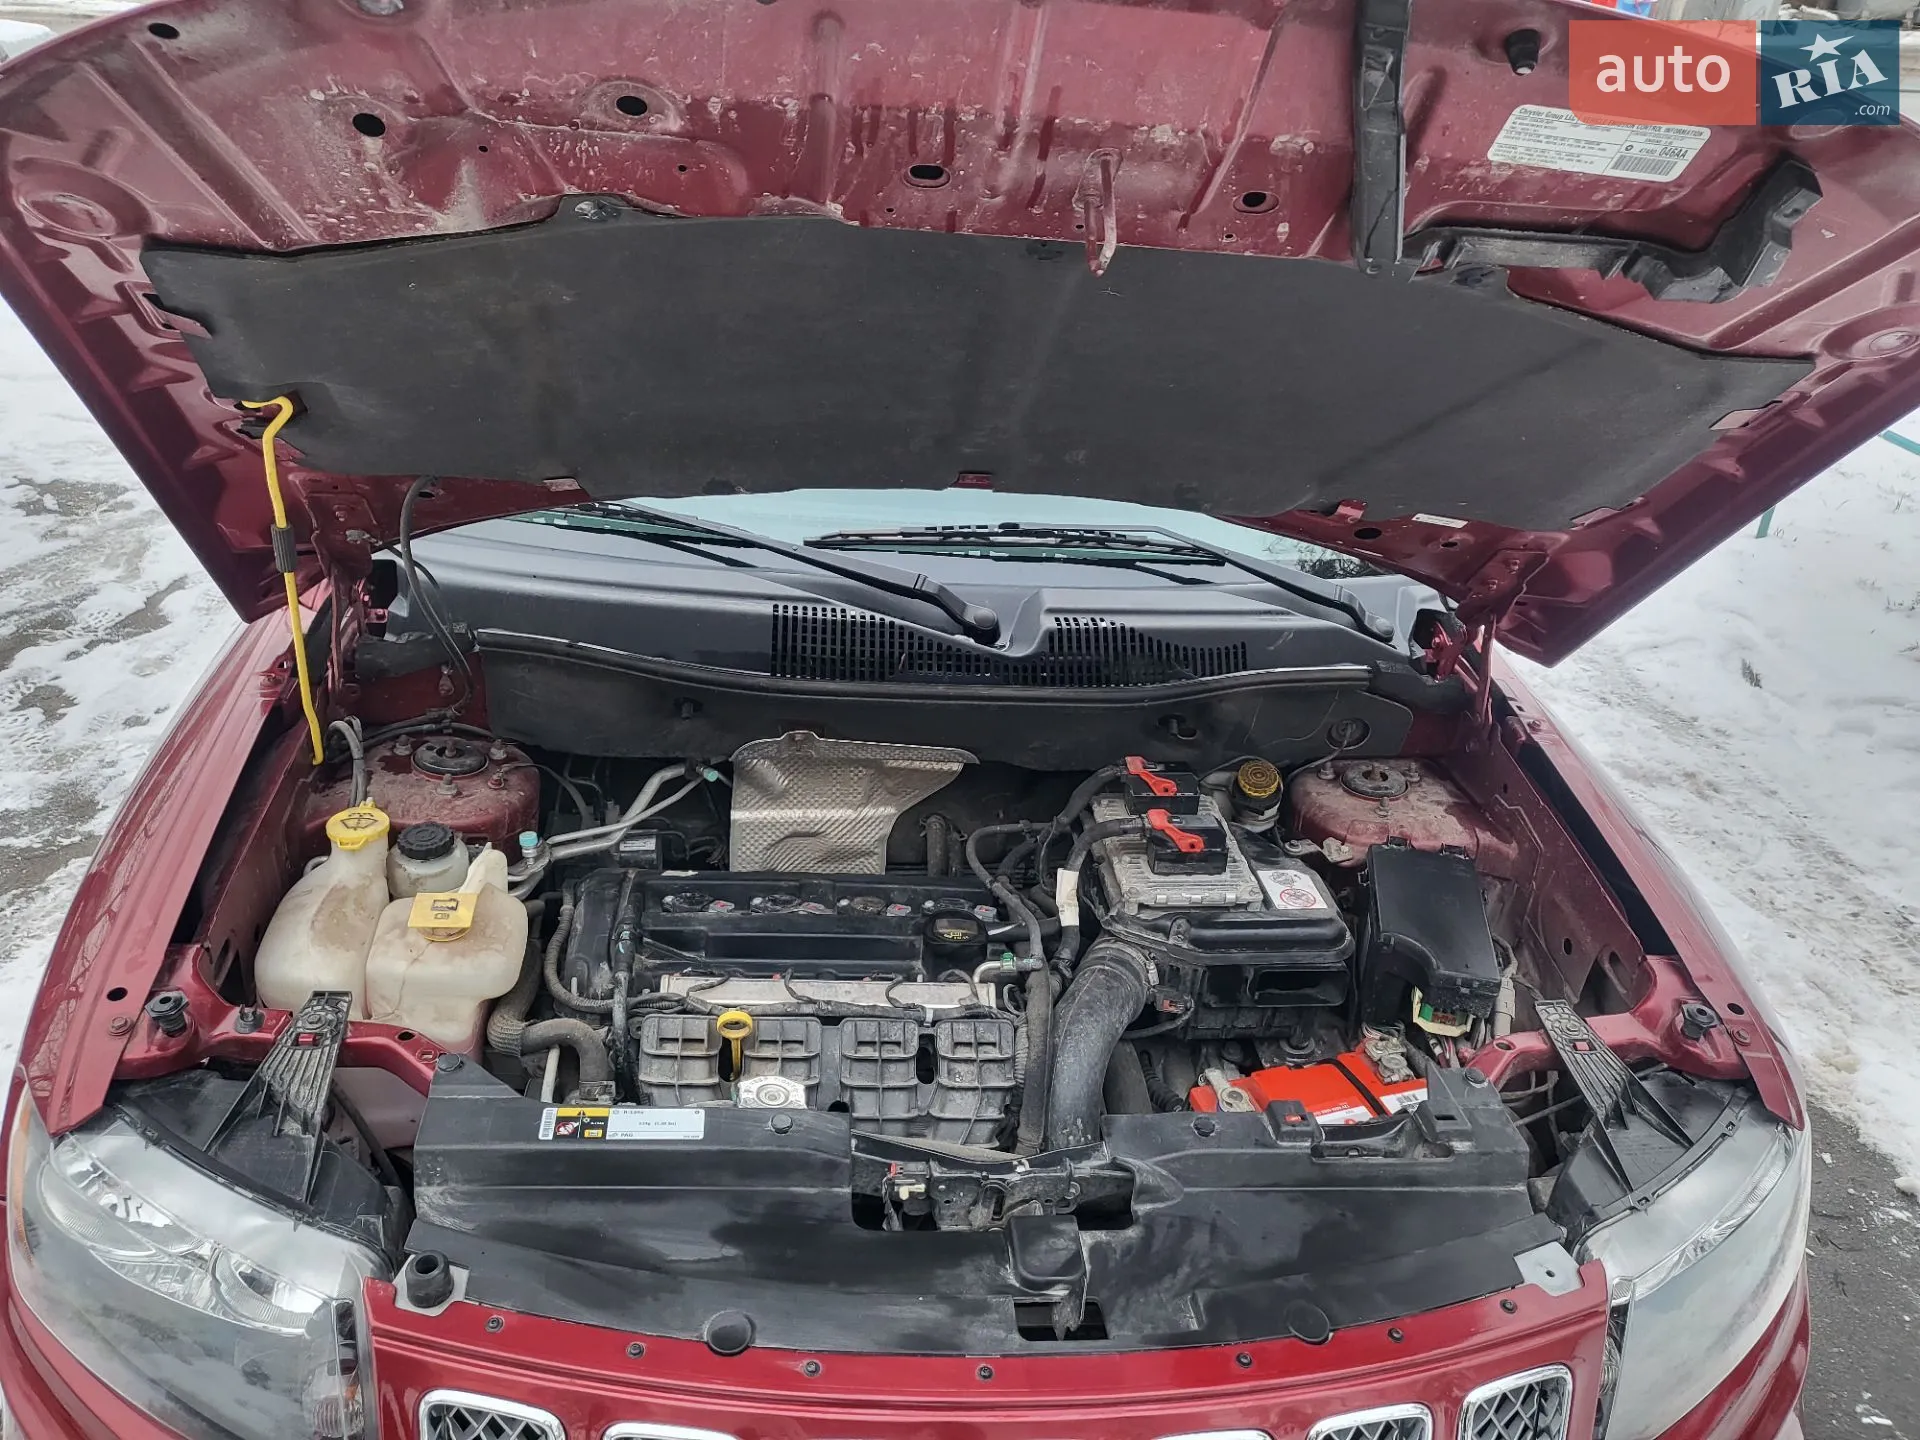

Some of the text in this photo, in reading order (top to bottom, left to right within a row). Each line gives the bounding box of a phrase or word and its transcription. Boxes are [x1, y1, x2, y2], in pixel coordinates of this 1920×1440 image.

[1519, 107, 1545, 117] Chrysler
[1545, 111, 1564, 121] Group
[1636, 124, 1663, 132] CONTROL
[1663, 126, 1705, 137] INFORMATION
[1658, 146, 1689, 159] 046AA
